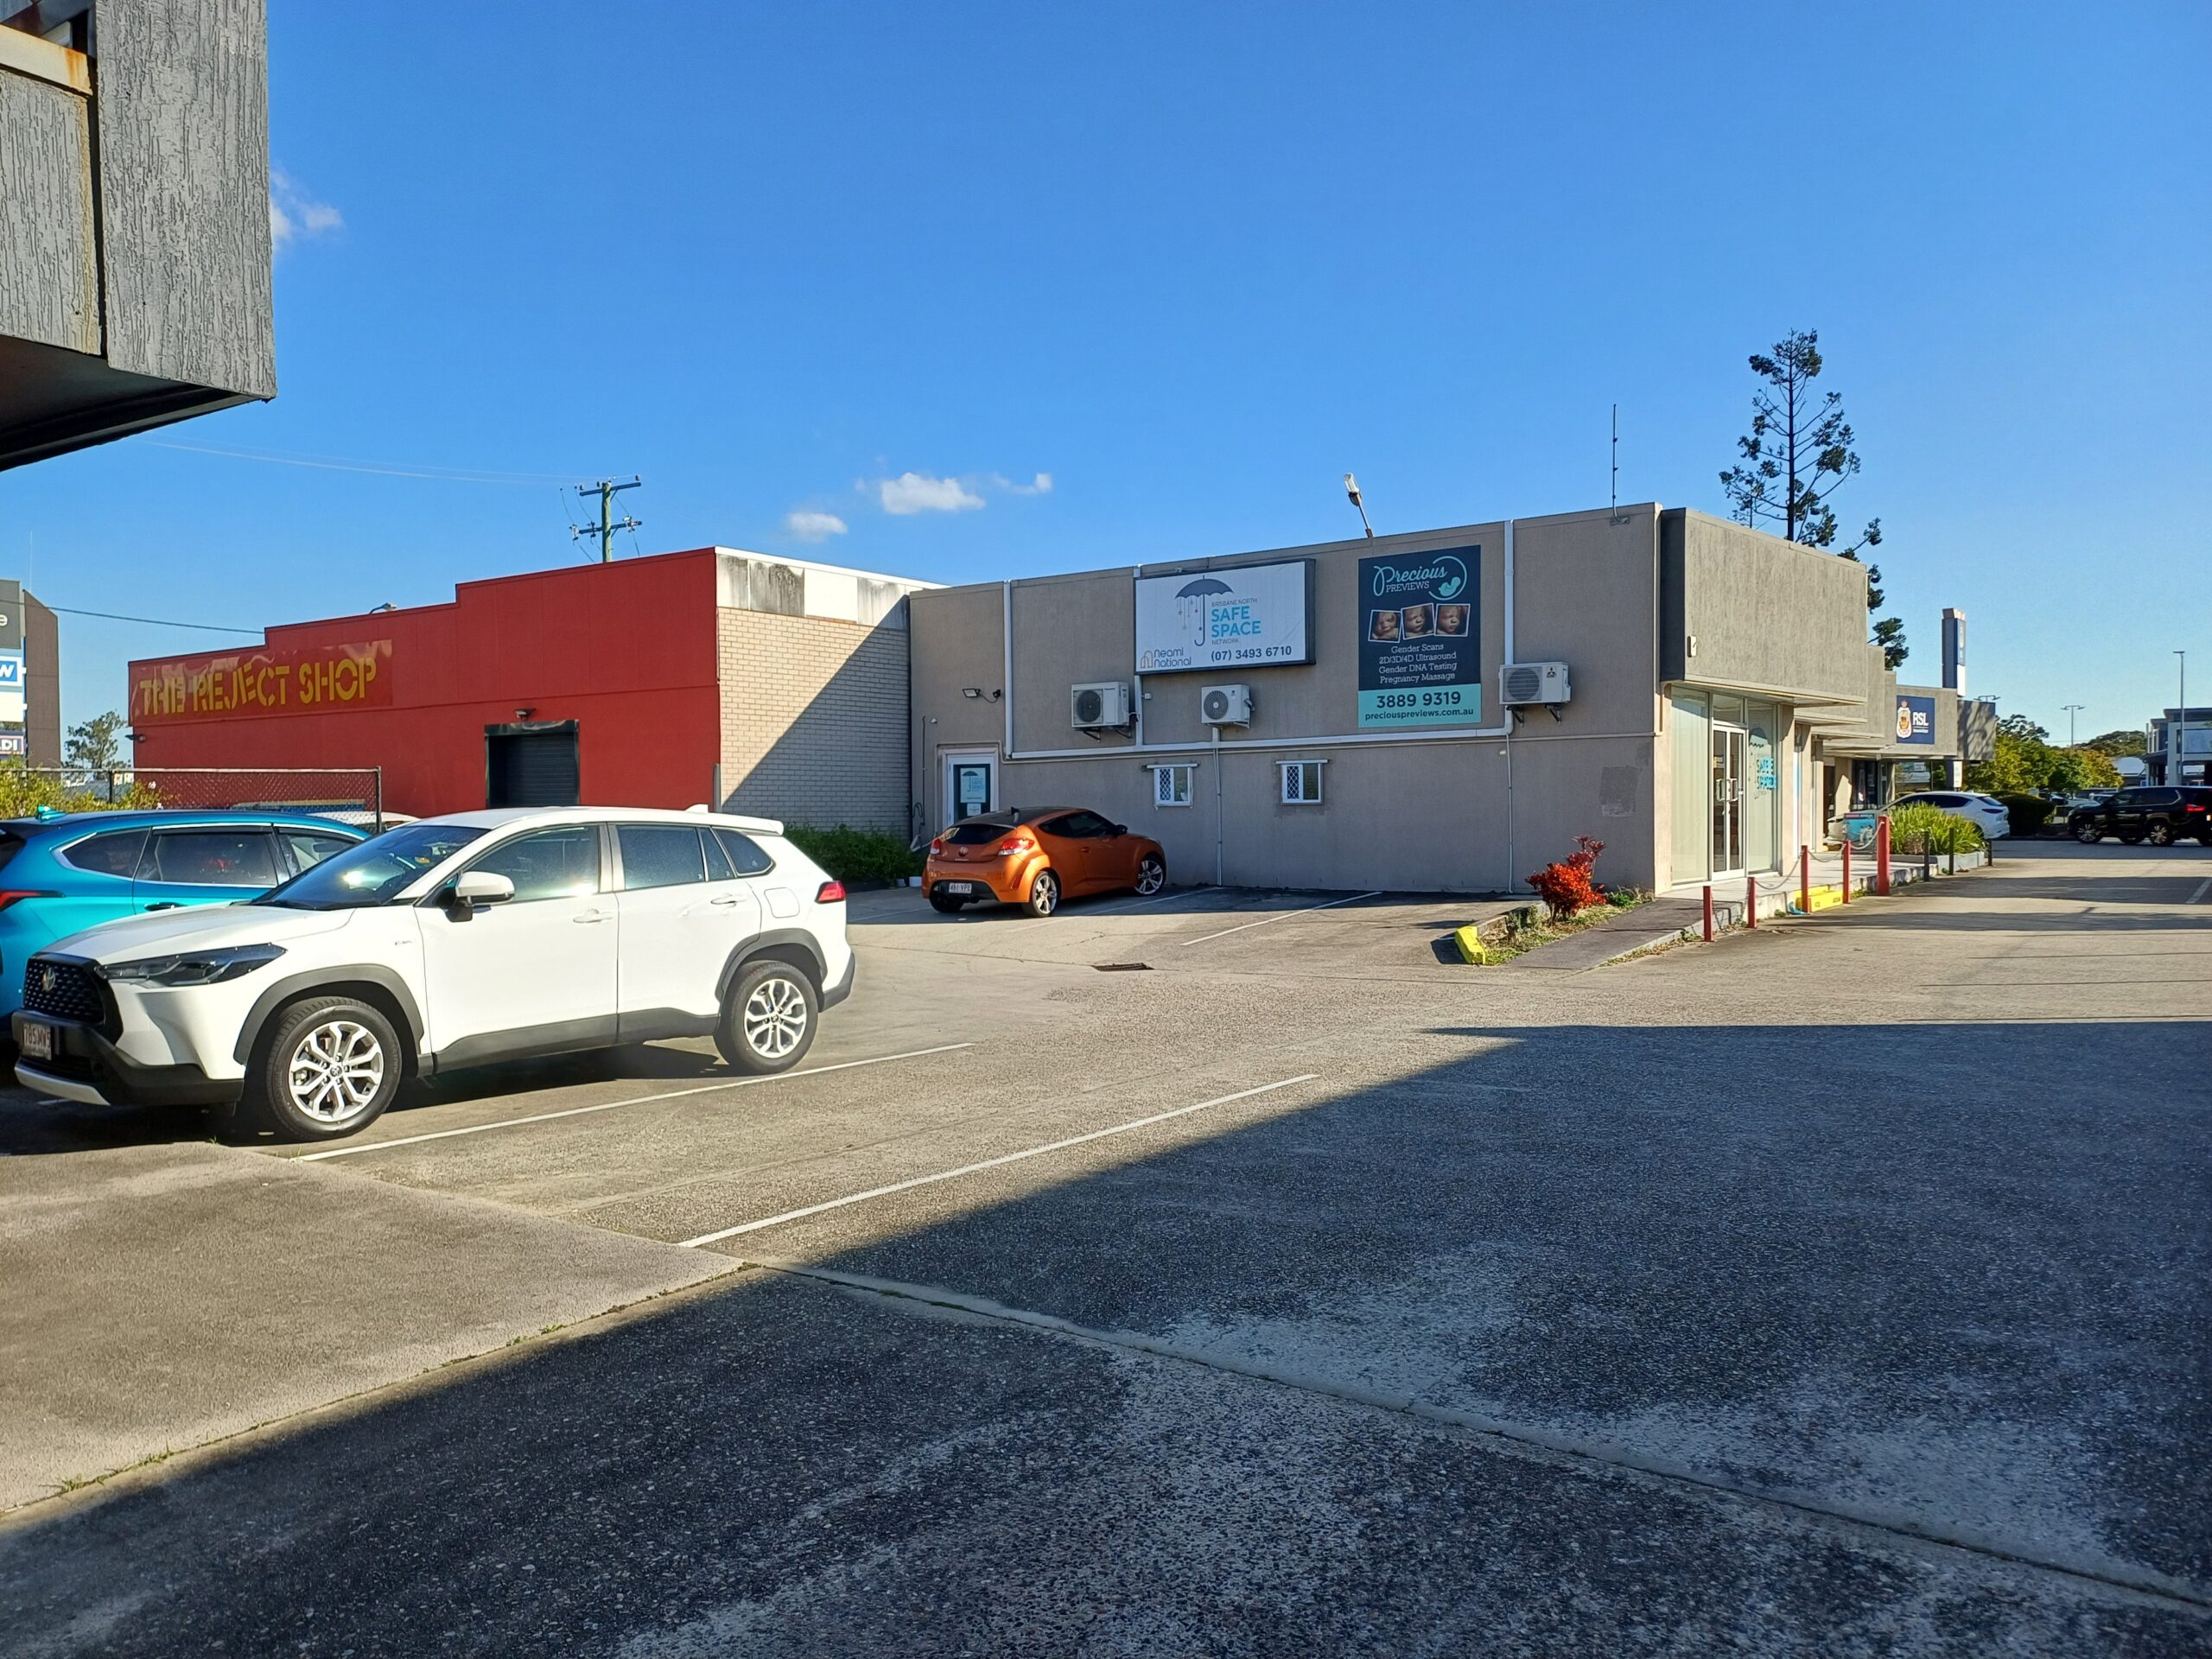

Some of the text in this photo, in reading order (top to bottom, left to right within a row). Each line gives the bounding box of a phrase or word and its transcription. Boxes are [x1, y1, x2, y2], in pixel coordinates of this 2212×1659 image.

[1373, 565, 1448, 596] Precious
[1386, 581, 1430, 594] PREVIEWS
[1211, 606, 1250, 622] SAFE
[1211, 620, 1262, 638] SPACE
[1211, 645, 1292, 662] (07) 3493 6710
[1391, 645, 1421, 653] Gender
[1154, 656, 1192, 668] national
[1379, 651, 1457, 664] 2D/3D/4D Ultrasound
[1378, 662, 1458, 674] Gender DNA Testing
[193, 662, 290, 712] REJECT
[299, 656, 377, 704] SHOP
[1380, 672, 1455, 685] Pregnancy Massage
[1376, 691, 1461, 709] 3889 9319
[1365, 708, 1473, 721] preciouspreviews.com.au
[1912, 711, 1929, 726] RSL
